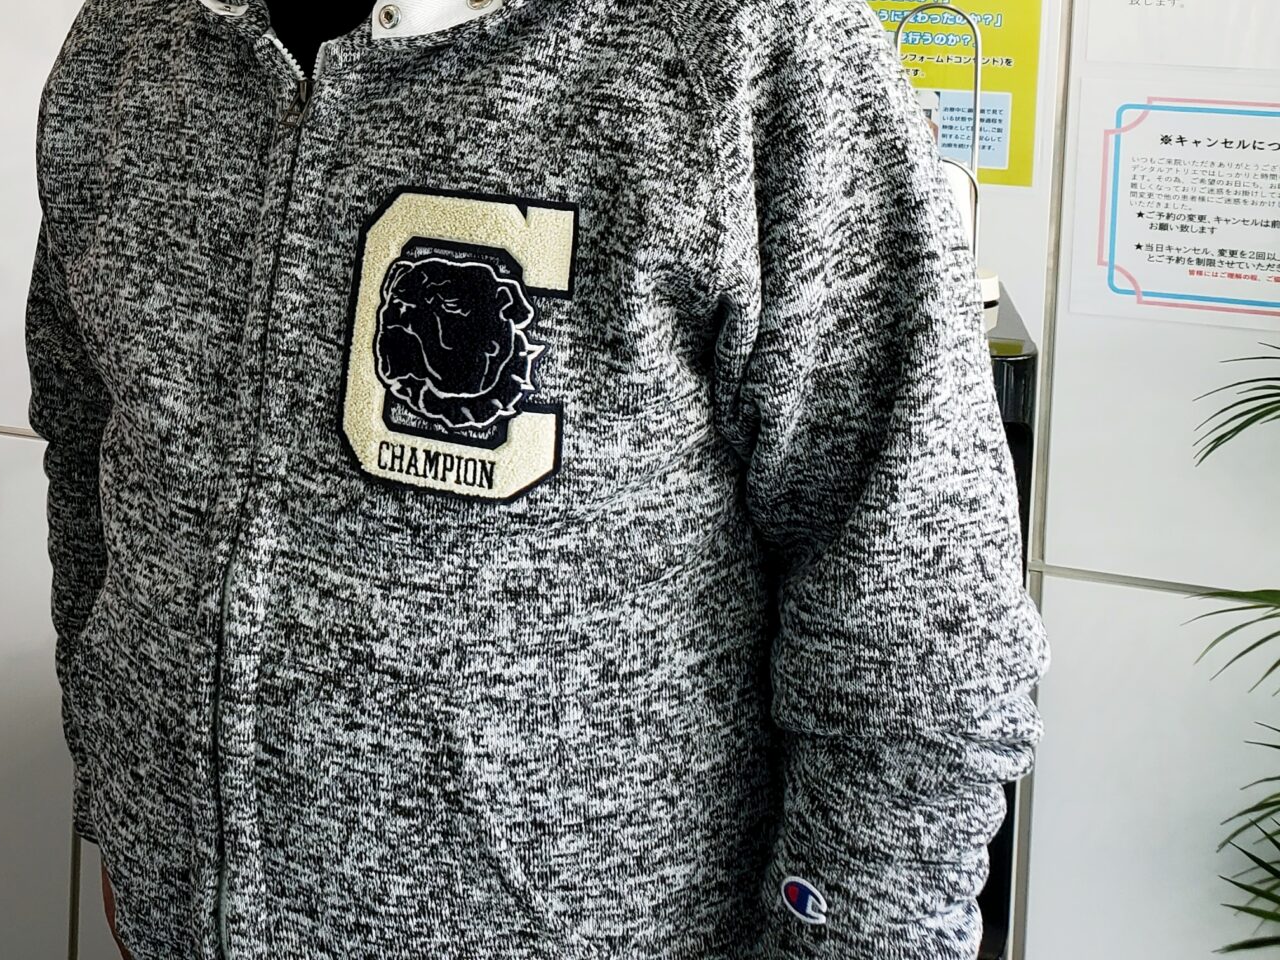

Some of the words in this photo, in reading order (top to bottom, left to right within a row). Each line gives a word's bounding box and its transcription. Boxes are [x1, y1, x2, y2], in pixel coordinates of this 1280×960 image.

[1131, 164, 1280, 180] デンタルアトリエではしっかりと時間
[377, 440, 496, 490] CHAMPION
